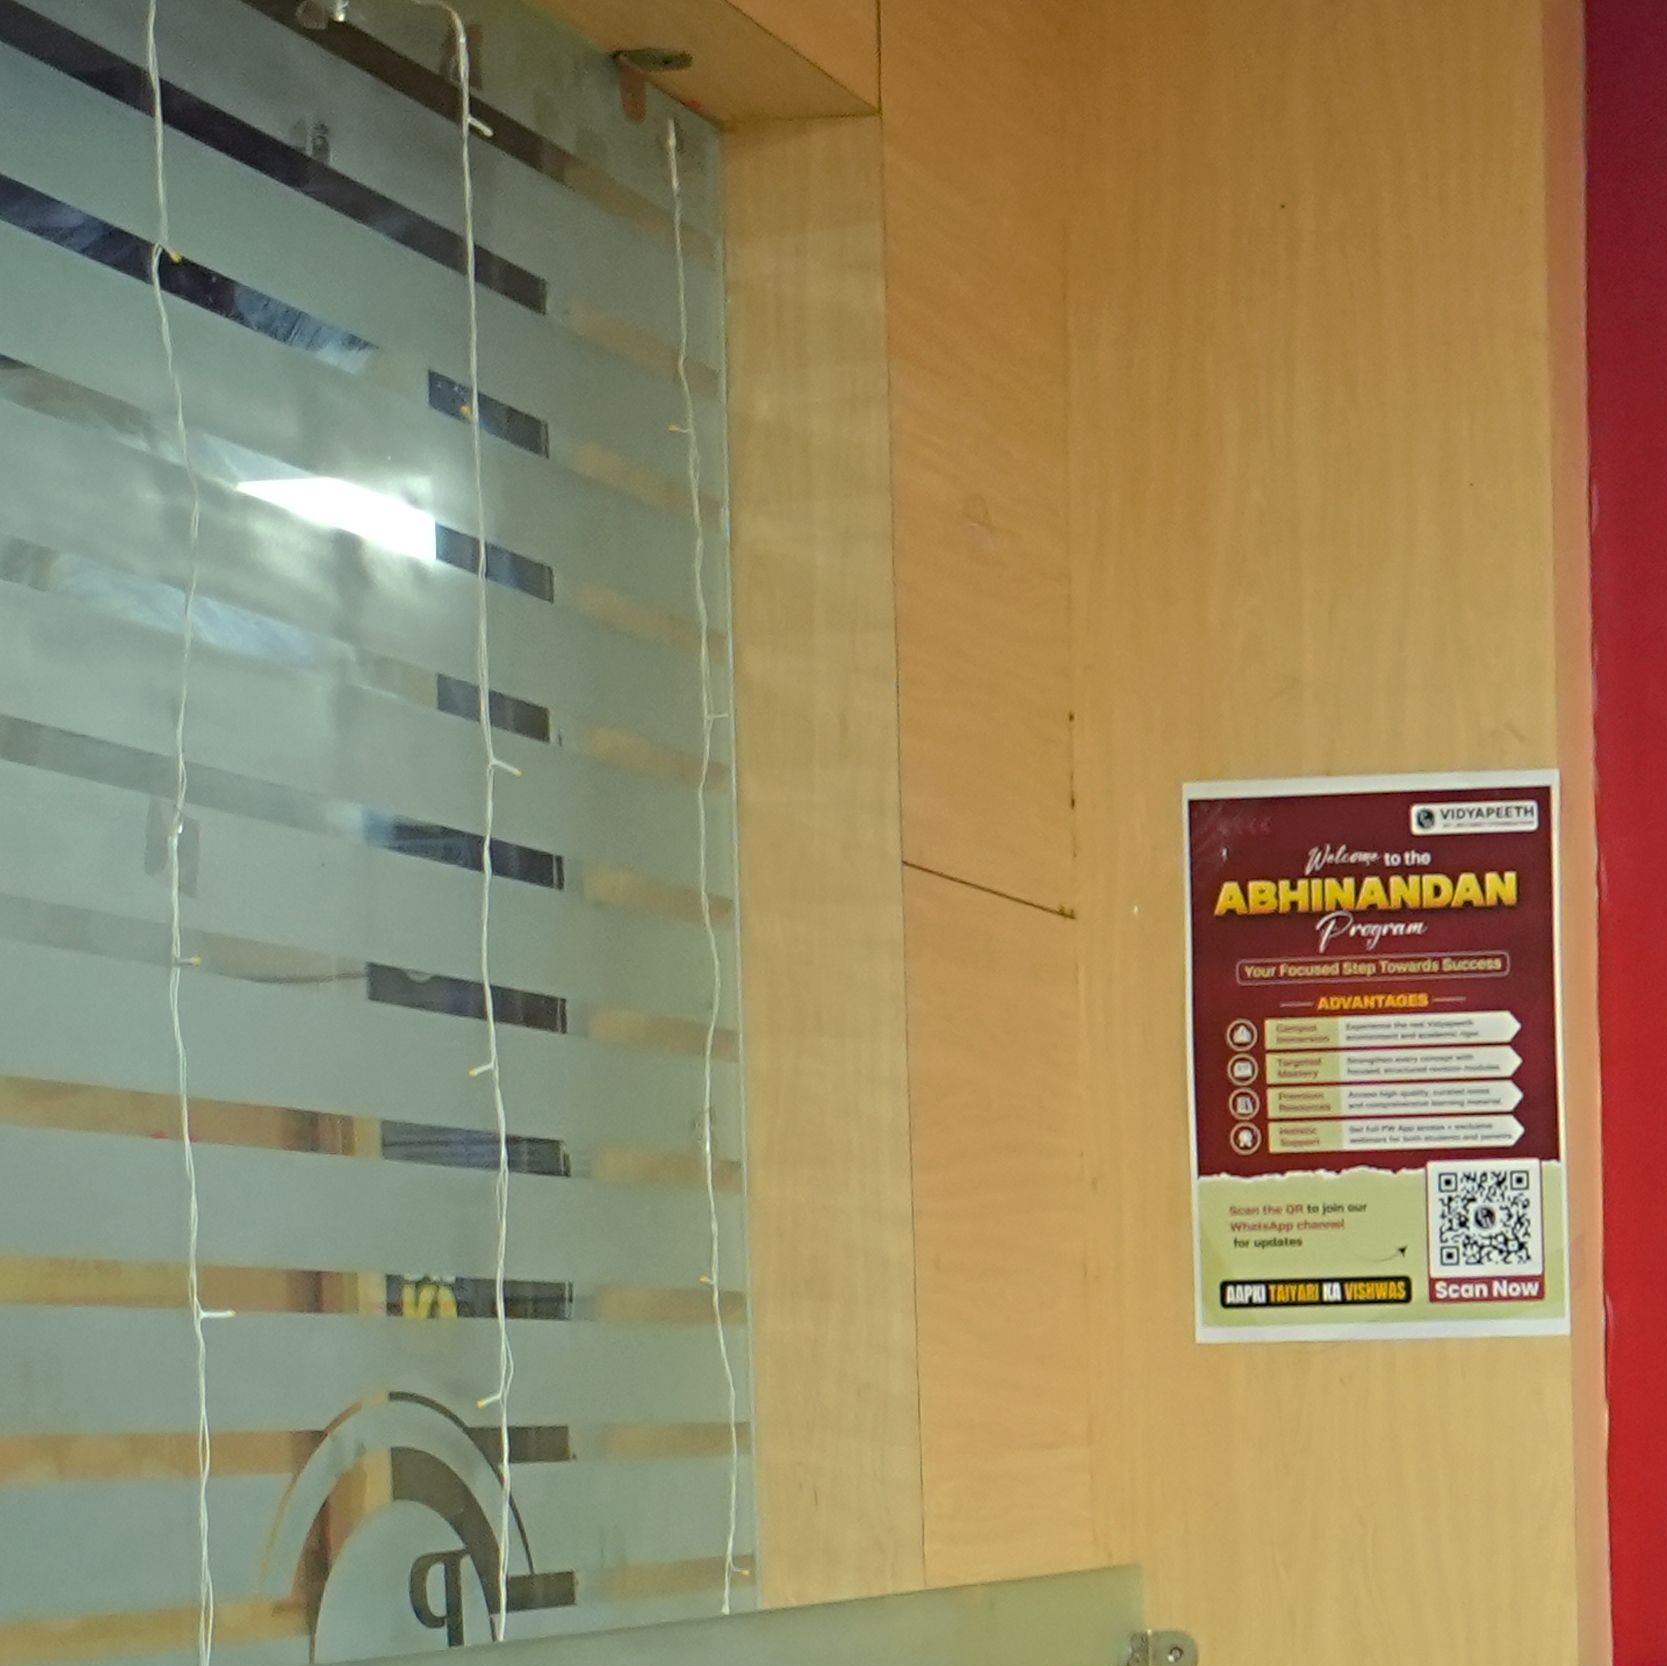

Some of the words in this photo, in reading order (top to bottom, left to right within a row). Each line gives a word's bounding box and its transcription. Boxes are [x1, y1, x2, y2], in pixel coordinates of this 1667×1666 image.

[1440, 805, 1534, 820] VIDYAPEETH
[1305, 845, 1379, 875] Welcome
[1384, 852, 1400, 866] to
[1404, 850, 1431, 865] the
[1215, 872, 1517, 915] ABHINANDAN
[1316, 911, 1427, 953] Program
[1245, 966, 1275, 979] Your
[1280, 964, 1339, 977] Focused
[1343, 962, 1375, 977] Step
[1380, 960, 1439, 973] Towards
[1442, 958, 1502, 971] Success
[1317, 993, 1428, 1010] ADVANTAGES
[1230, 1206, 1260, 1216] Scan
[1262, 1205, 1283, 1215] the
[1285, 1205, 1304, 1215] QR
[1307, 1204, 1319, 1213] to
[1321, 1202, 1343, 1215] join
[1347, 1203, 1367, 1213] our
[1230, 1221, 1293, 1233] WhatsApp
[1297, 1219, 1345, 1229] channel
[1234, 1237, 1249, 1247] for
[1253, 1237, 1302, 1249] updates
[1226, 1284, 1266, 1304] AAPKI
[1269, 1283, 1319, 1301] TAIYARI
[1323, 1283, 1341, 1300] KA
[1345, 1281, 1406, 1299] VISHWAS
[1435, 1281, 1488, 1298] Scan
[1492, 1278, 1539, 1297] Now
